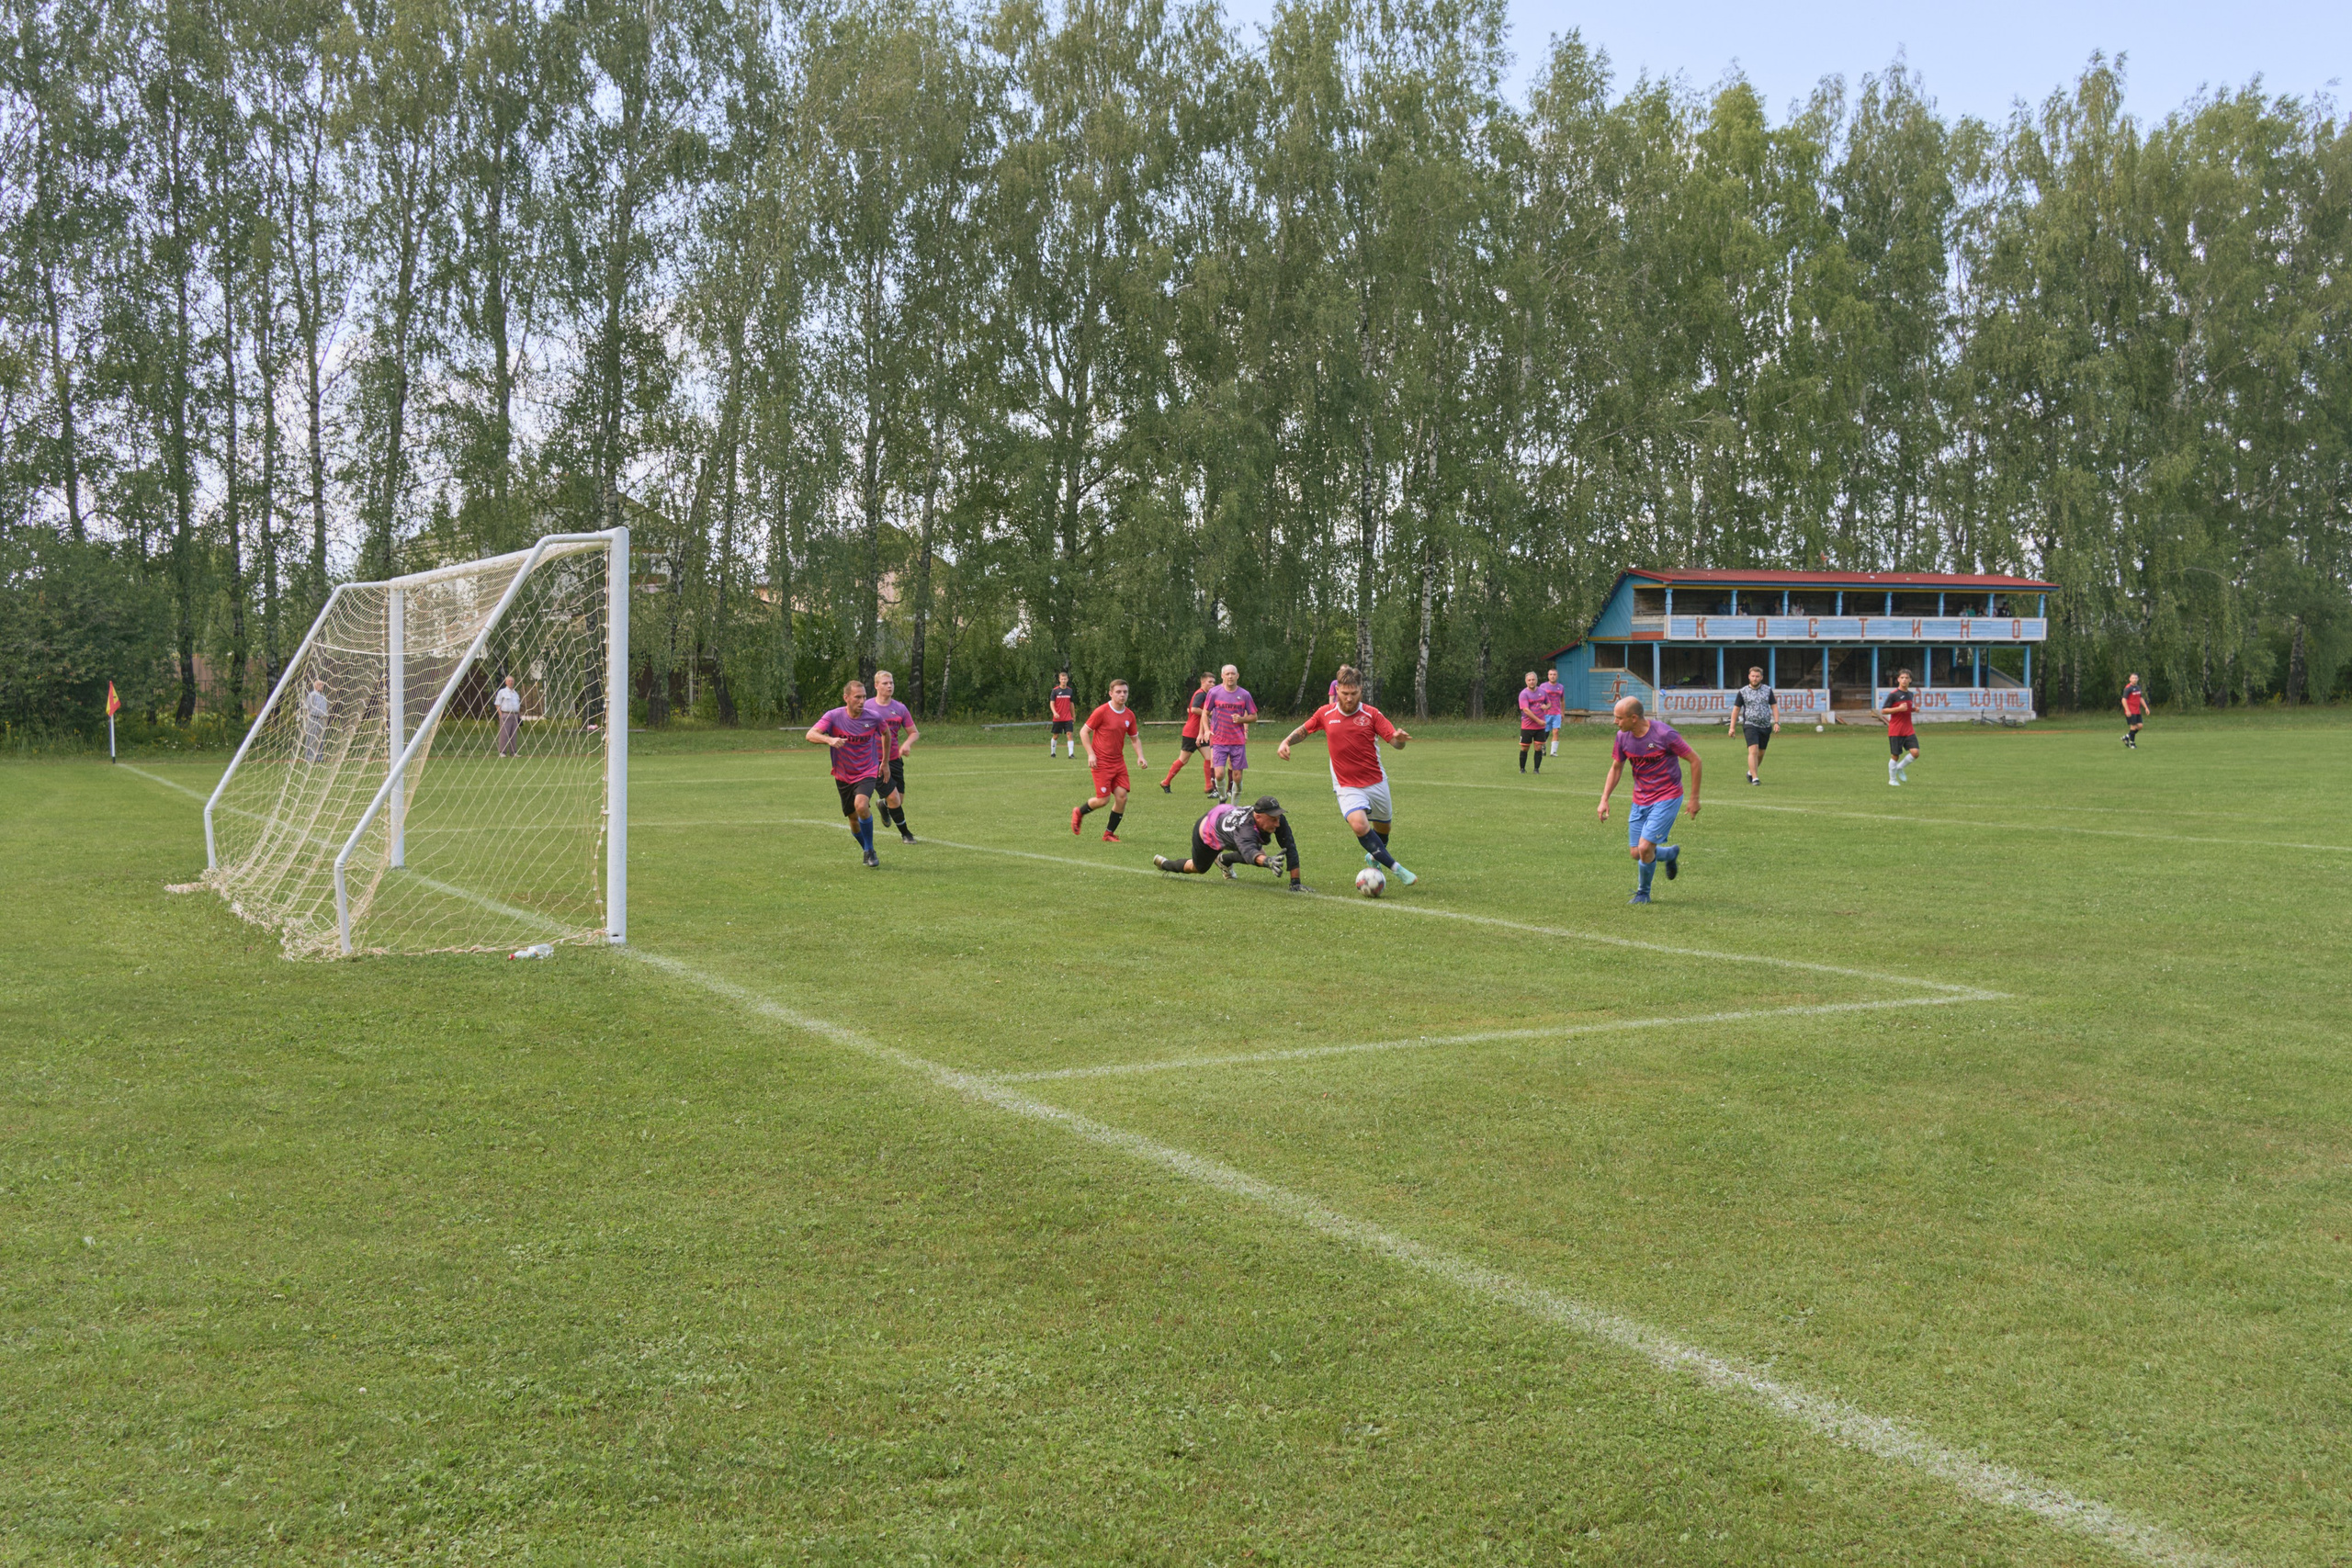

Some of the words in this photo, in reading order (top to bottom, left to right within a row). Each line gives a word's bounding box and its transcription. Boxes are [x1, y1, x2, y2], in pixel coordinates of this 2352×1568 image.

[1696, 616, 2021, 638] КОСТИНО
[1664, 695, 1731, 713] спорт
[1969, 688, 2025, 711] идут
